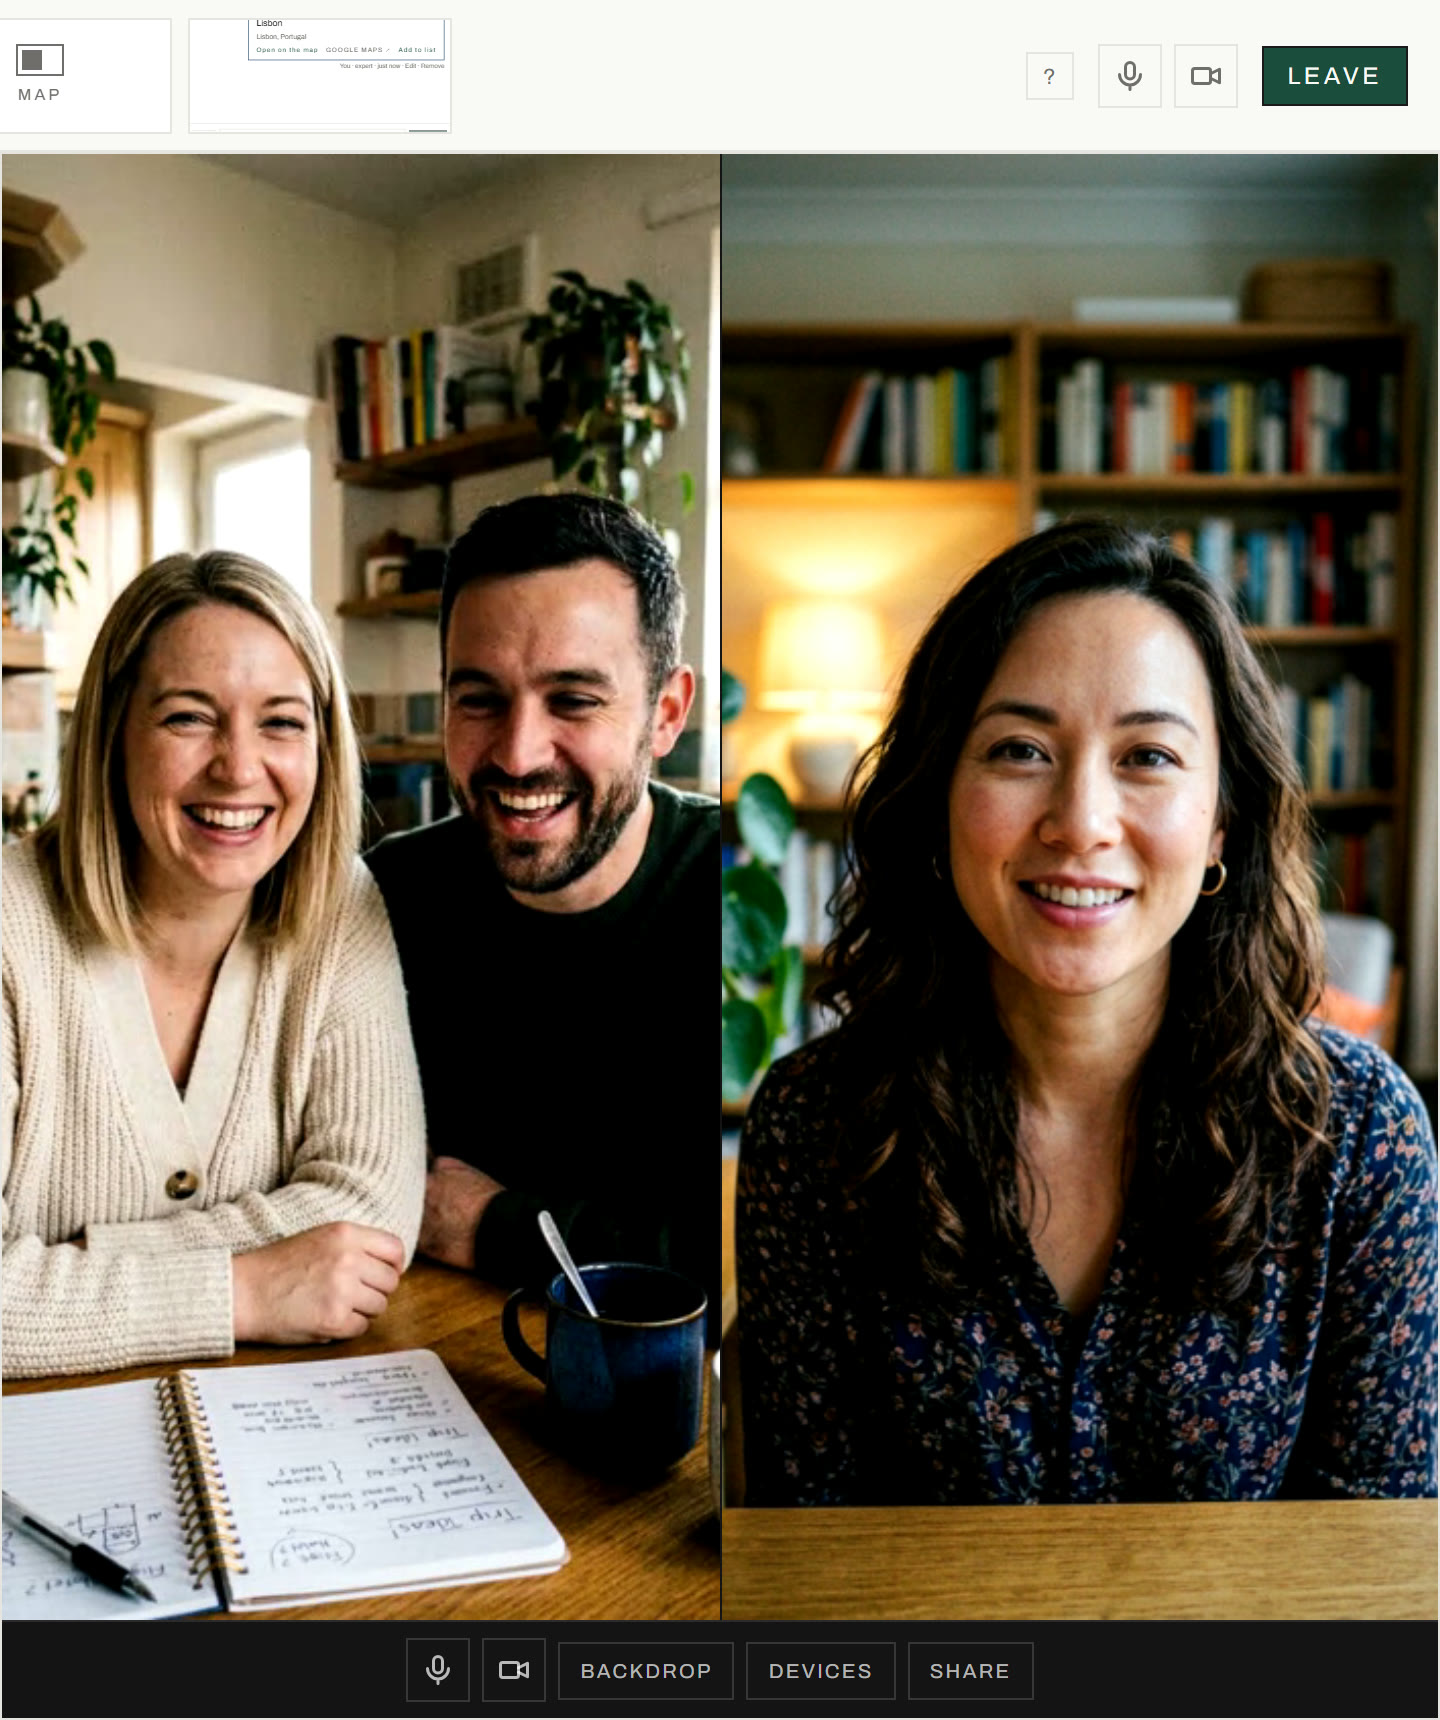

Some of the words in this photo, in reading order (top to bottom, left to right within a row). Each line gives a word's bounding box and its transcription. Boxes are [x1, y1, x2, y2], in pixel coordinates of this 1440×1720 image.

[256, 19, 283, 27] Lisbon
[1043, 67, 1055, 85] ?
[1288, 66, 1379, 85] LEAVE
[18, 88, 60, 101] MAP
[581, 1663, 711, 1679] BACKDROP
[769, 1663, 872, 1679] DEVICES
[930, 1663, 1009, 1679] SHARE
